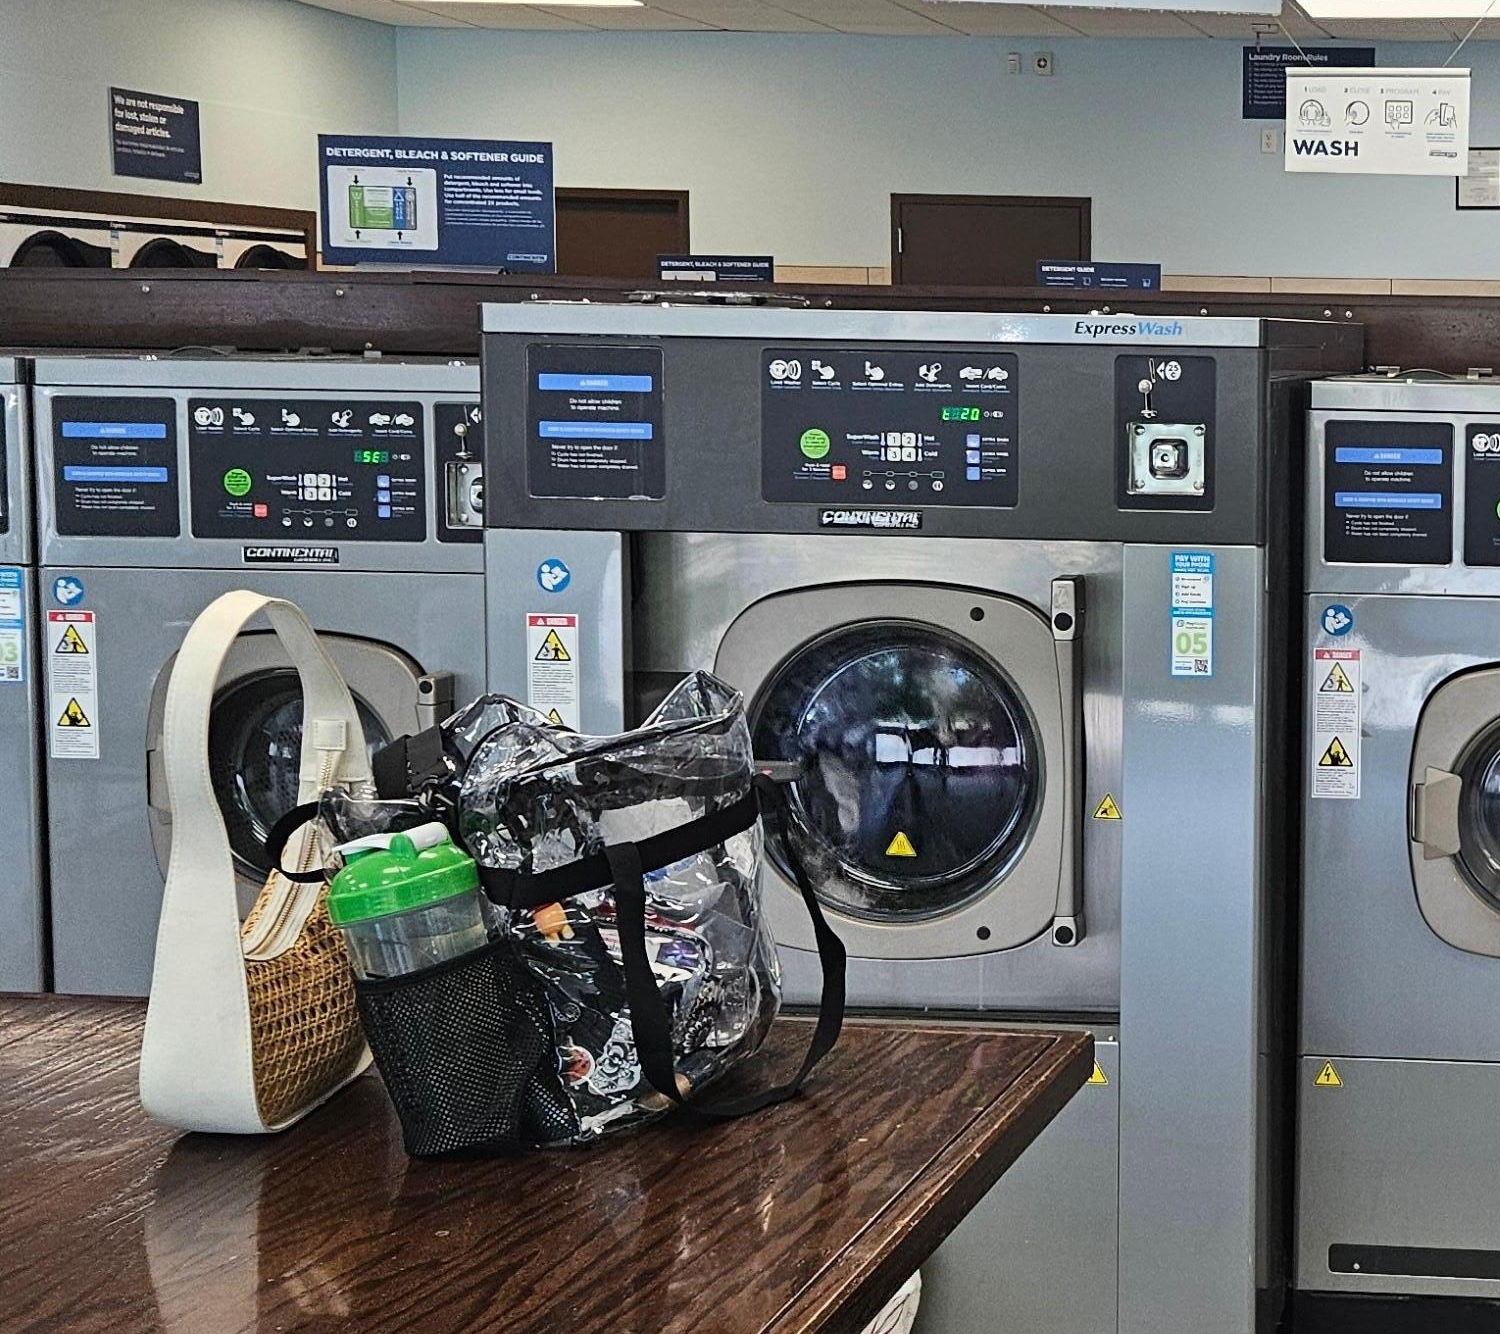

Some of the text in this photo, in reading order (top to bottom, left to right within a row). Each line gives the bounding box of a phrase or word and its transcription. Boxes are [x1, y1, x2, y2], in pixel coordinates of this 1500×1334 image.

[1249, 53, 1281, 62] Laundry
[113, 94, 184, 115] We are not responsible
[115, 108, 124, 118] for
[125, 109, 139, 122] lost,
[139, 113, 159, 124] stolen
[115, 121, 145, 135] damaged
[326, 147, 545, 163] DETERGENT, BLEACH & SOFTENER GUIDE
[1293, 139, 1359, 157] WASH
[1074, 321, 1182, 338] ExpressWash
[961, 408, 980, 421] 20
[906, 437, 912, 445] 2
[892, 451, 912, 460] 3 4
[246, 548, 334, 557] CONTINENTAL
[1175, 632, 1208, 655] 05
[0, 643, 18, 662] 3
